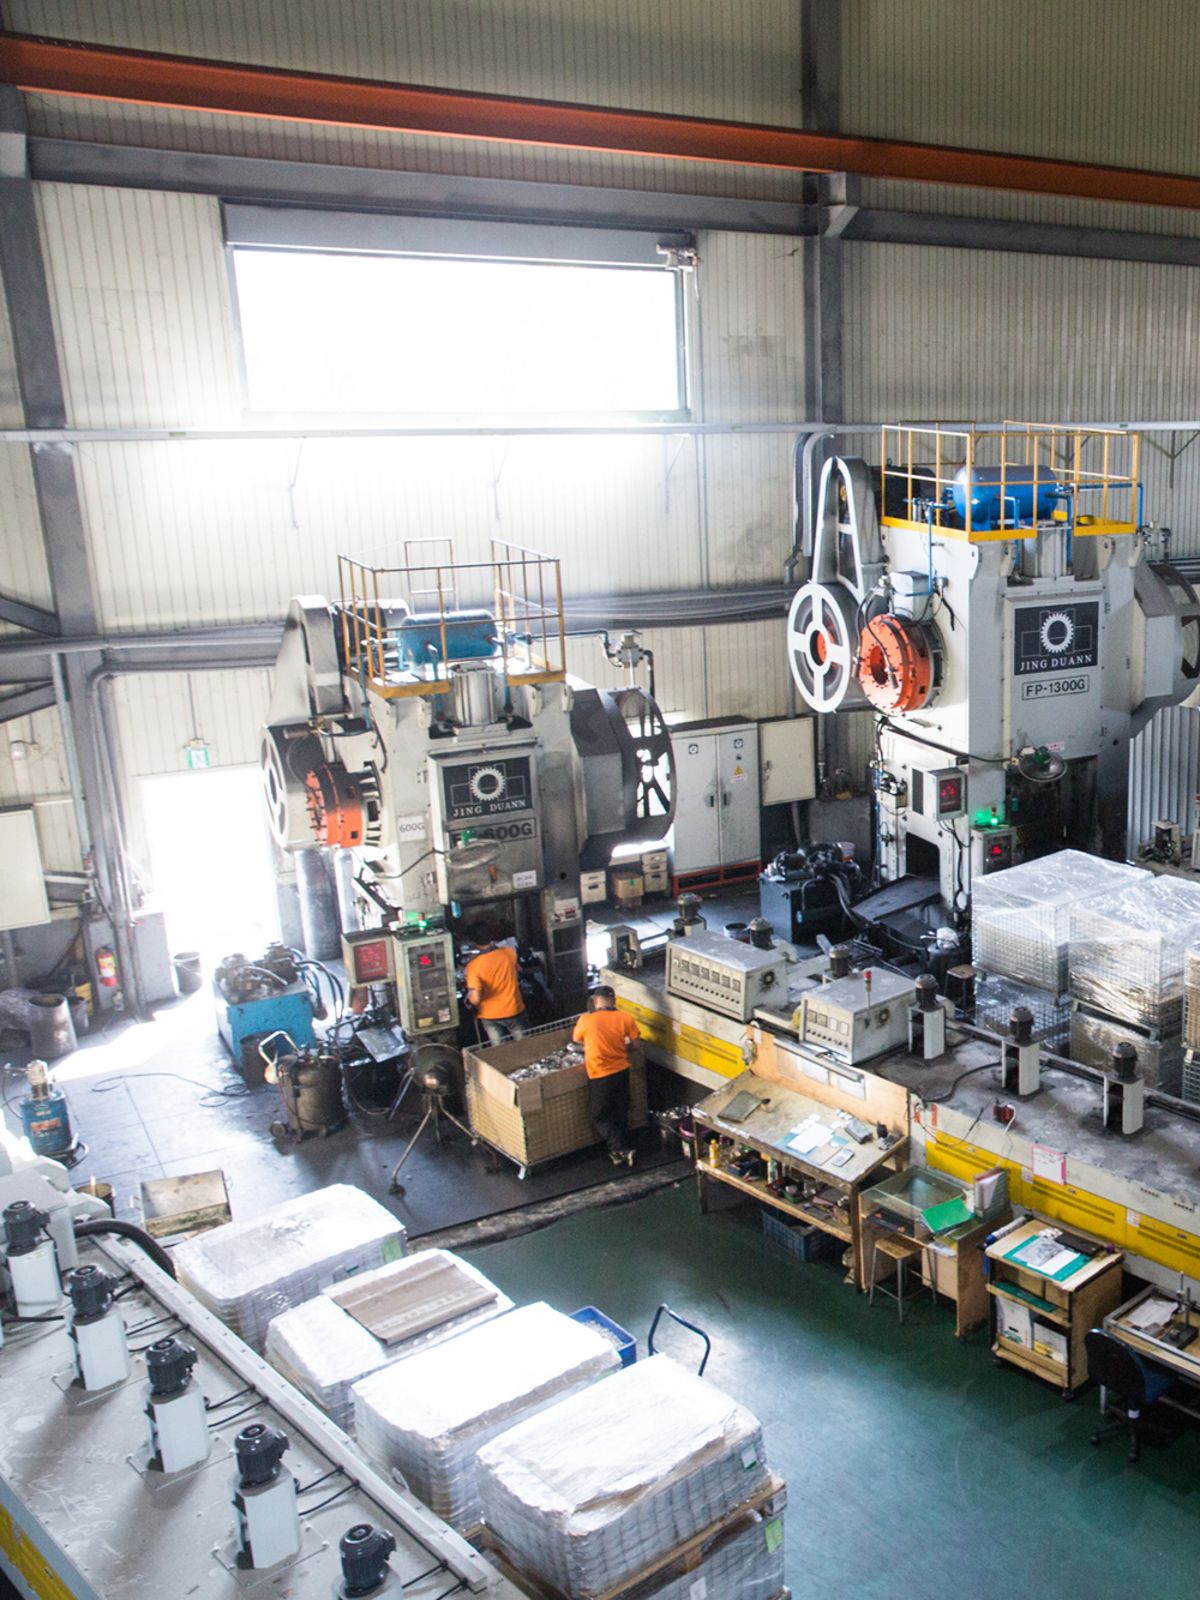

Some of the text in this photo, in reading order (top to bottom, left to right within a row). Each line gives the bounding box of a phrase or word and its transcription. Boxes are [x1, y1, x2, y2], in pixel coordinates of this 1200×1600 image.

[1019, 654, 1092, 671] JING DUANN
[1026, 678, 1085, 696] FP-1300G
[453, 799, 526, 817] JING DUANN
[400, 822, 425, 832] 600G
